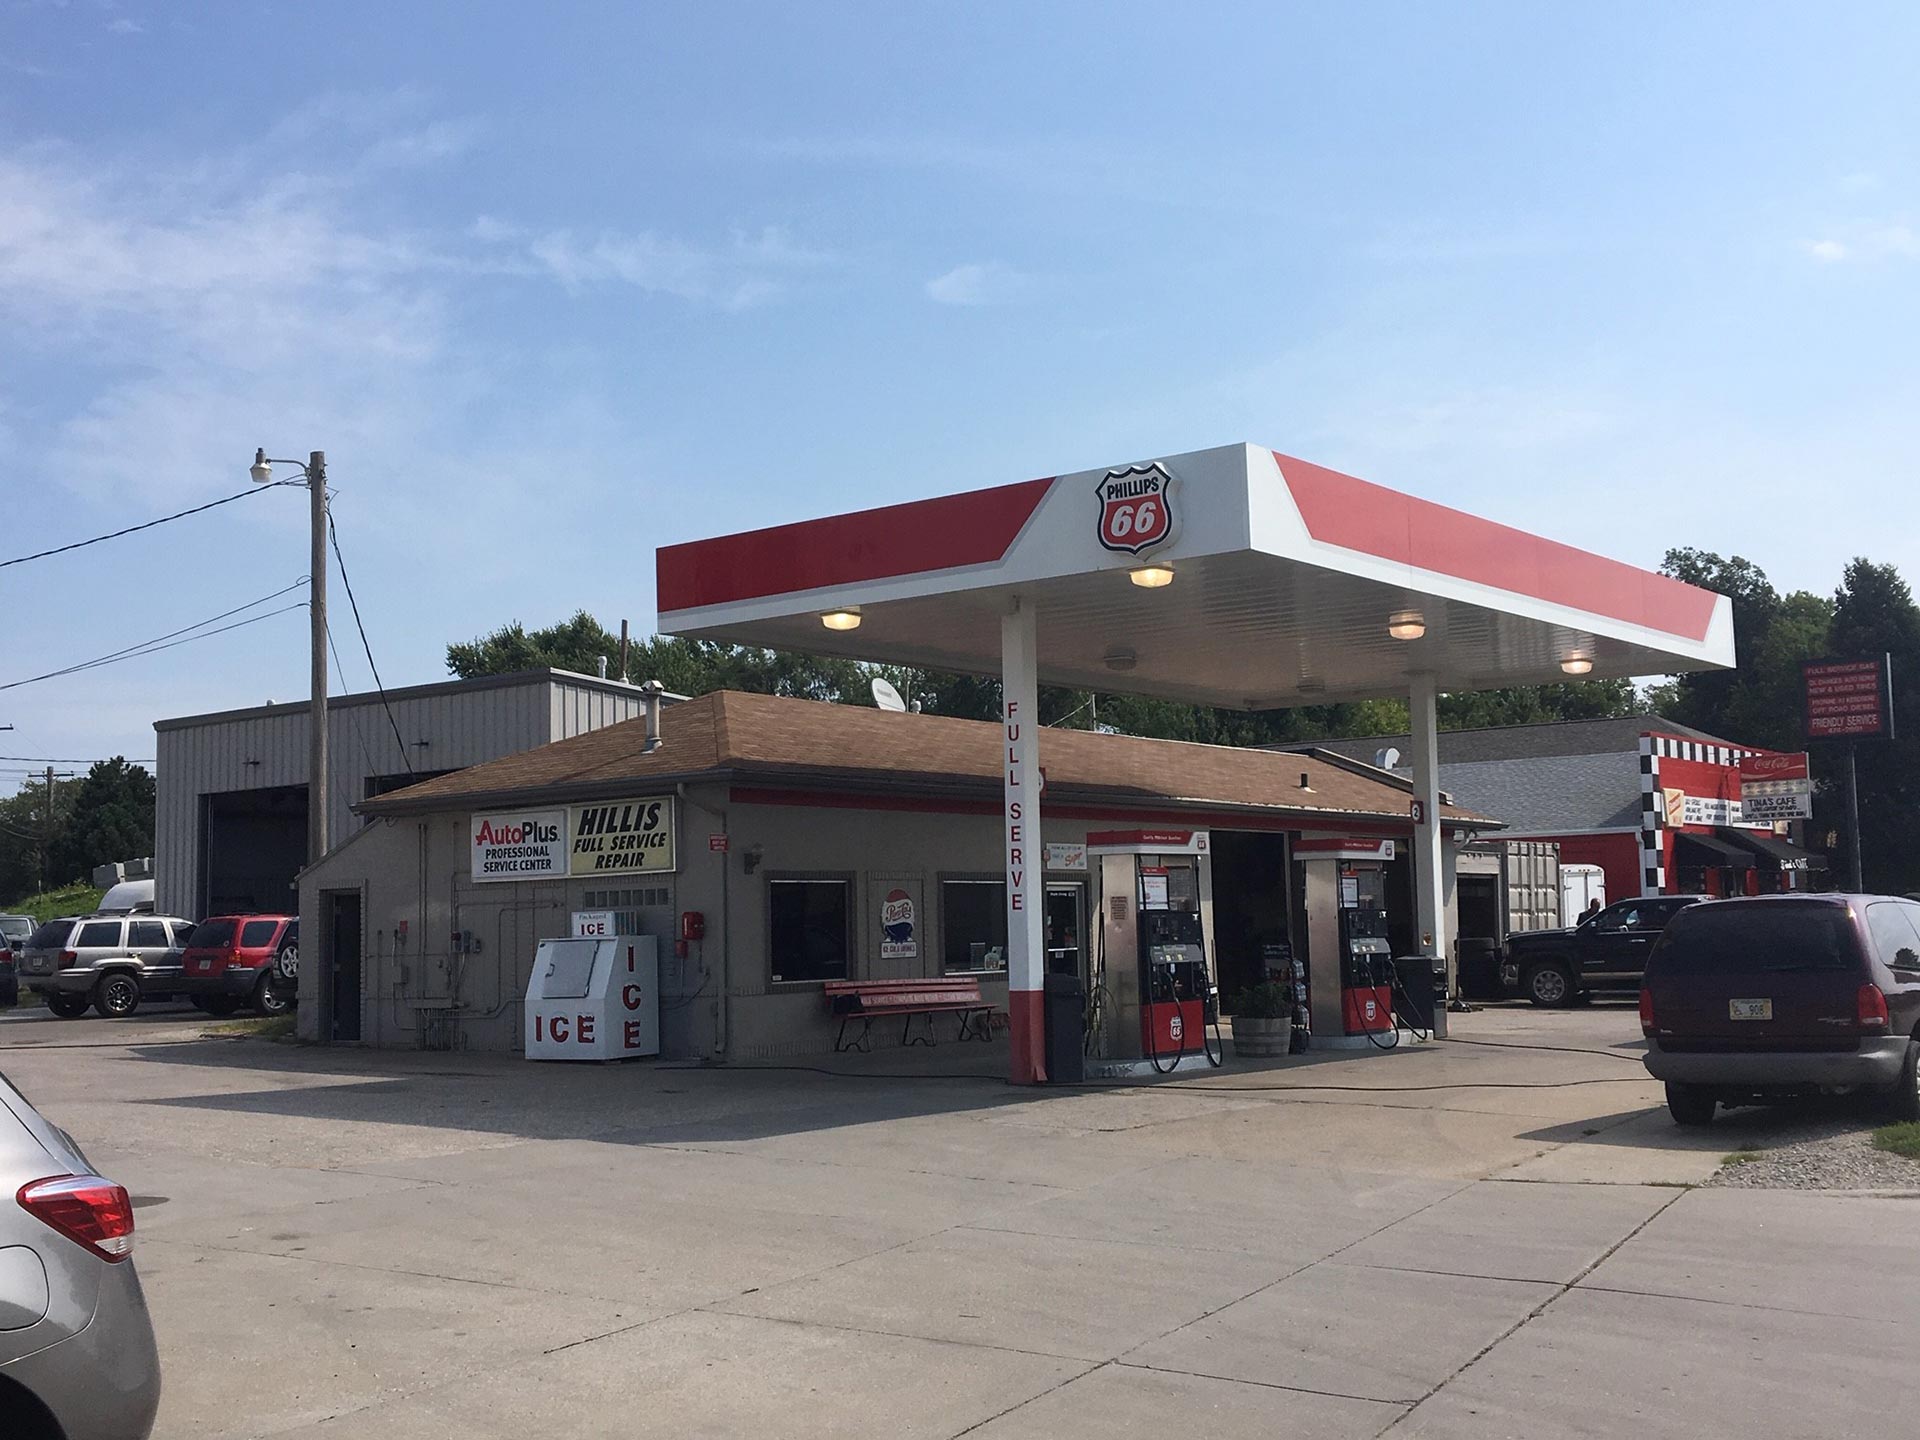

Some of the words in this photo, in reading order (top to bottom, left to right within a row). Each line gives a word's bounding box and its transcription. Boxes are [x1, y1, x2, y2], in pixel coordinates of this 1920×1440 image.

[1107, 476, 1160, 500] PHILLIPS
[1110, 501, 1157, 538] 66
[1811, 716, 1845, 728] FRIENDLY
[1846, 714, 1878, 726] SERVICE
[1008, 702, 1020, 786] FULL
[1412, 807, 1419, 817] 2
[1747, 797, 1775, 807] TINA'S
[1775, 796, 1797, 806] CAFE
[577, 802, 661, 836] HILLIS
[485, 845, 550, 860] PROFESSIONAL
[573, 837, 604, 854] FULL
[610, 832, 667, 851] SERVICE
[483, 860, 519, 873] SERVICE
[519, 858, 552, 871] CENTER
[594, 852, 645, 870] REPAIR
[1009, 803, 1023, 910] SERVE
[581, 922, 605, 935] ICE
[622, 945, 641, 1049] ICE
[535, 1014, 595, 1044] ICE
